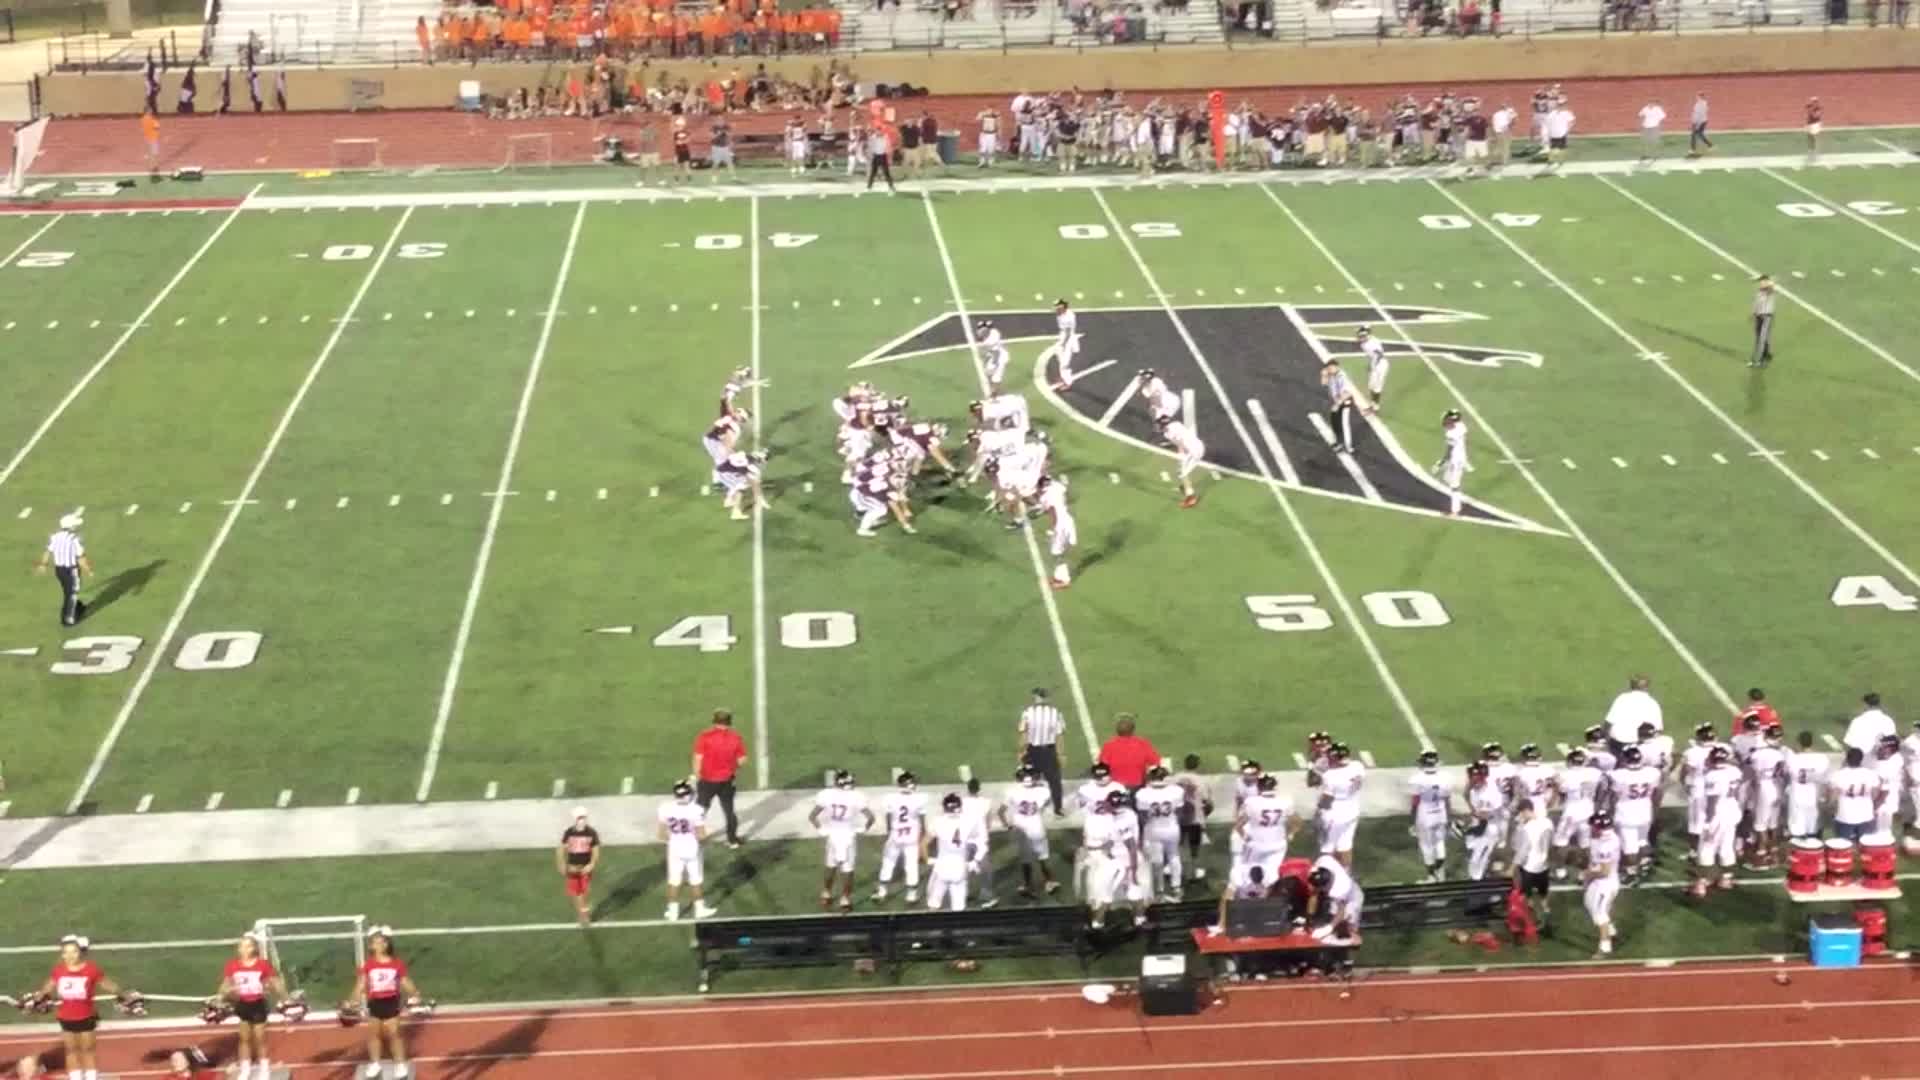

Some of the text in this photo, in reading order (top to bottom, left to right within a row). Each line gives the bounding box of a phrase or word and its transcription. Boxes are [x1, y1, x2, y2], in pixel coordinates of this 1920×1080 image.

[654, 611, 856, 651] 40
[1245, 591, 1450, 631] 50
[51, 631, 262, 673] 30
[898, 805, 909, 824] 2
[1259, 808, 1283, 828] 57
